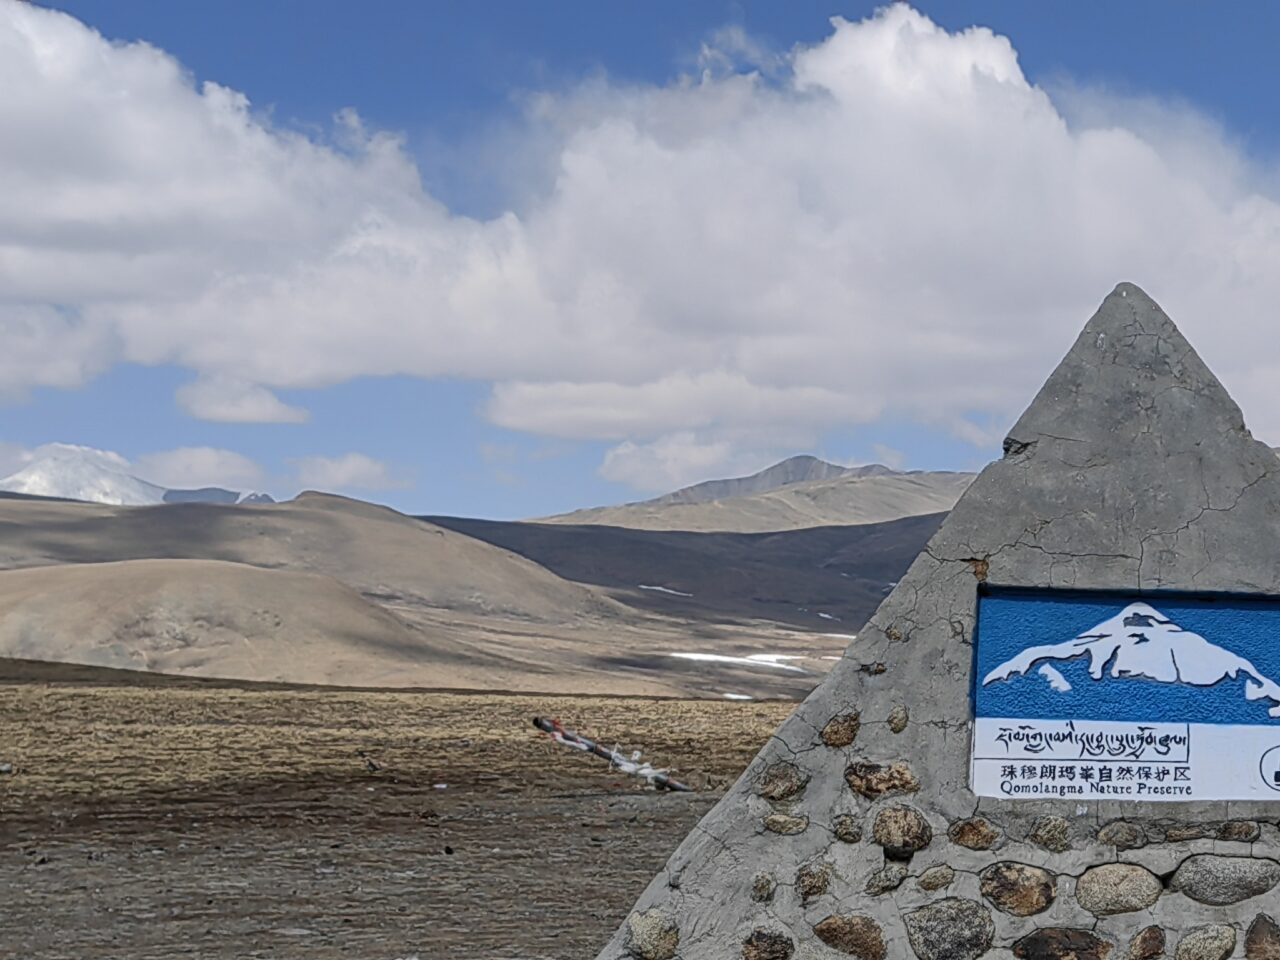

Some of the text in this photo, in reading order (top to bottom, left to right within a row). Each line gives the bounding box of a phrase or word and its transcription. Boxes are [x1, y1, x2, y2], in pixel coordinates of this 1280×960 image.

[1000, 781, 1192, 796] Qomolangma Nature Preserve
